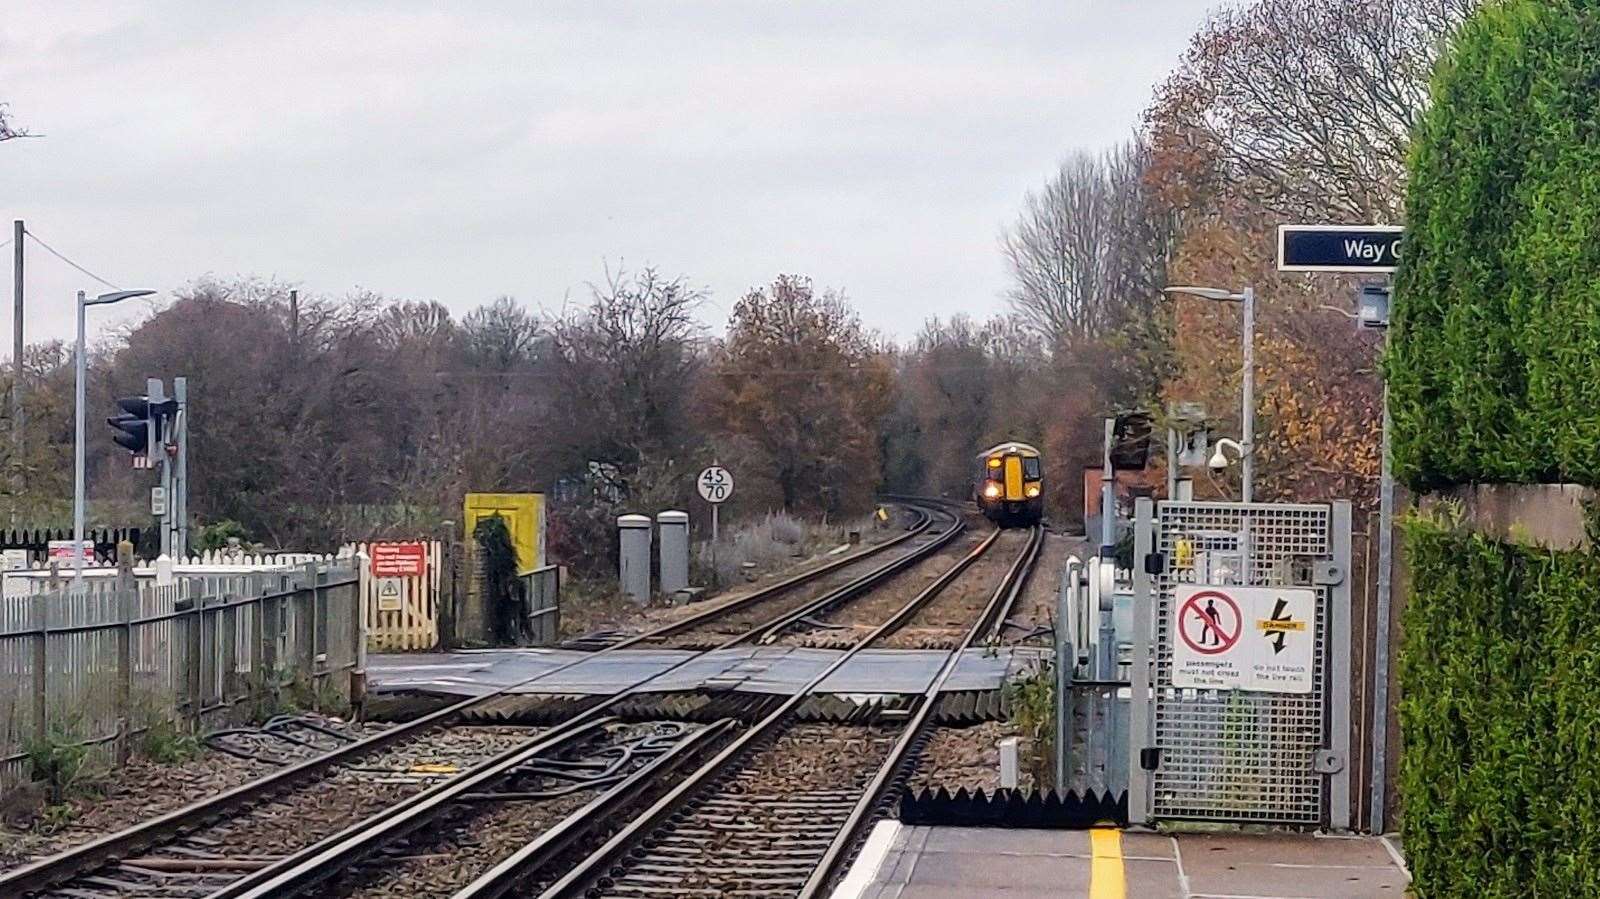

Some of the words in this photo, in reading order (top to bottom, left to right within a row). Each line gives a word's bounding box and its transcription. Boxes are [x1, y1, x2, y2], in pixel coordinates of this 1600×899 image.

[1344, 239, 1385, 262] Way
[703, 469, 724, 482] 45
[706, 485, 725, 499] 70
